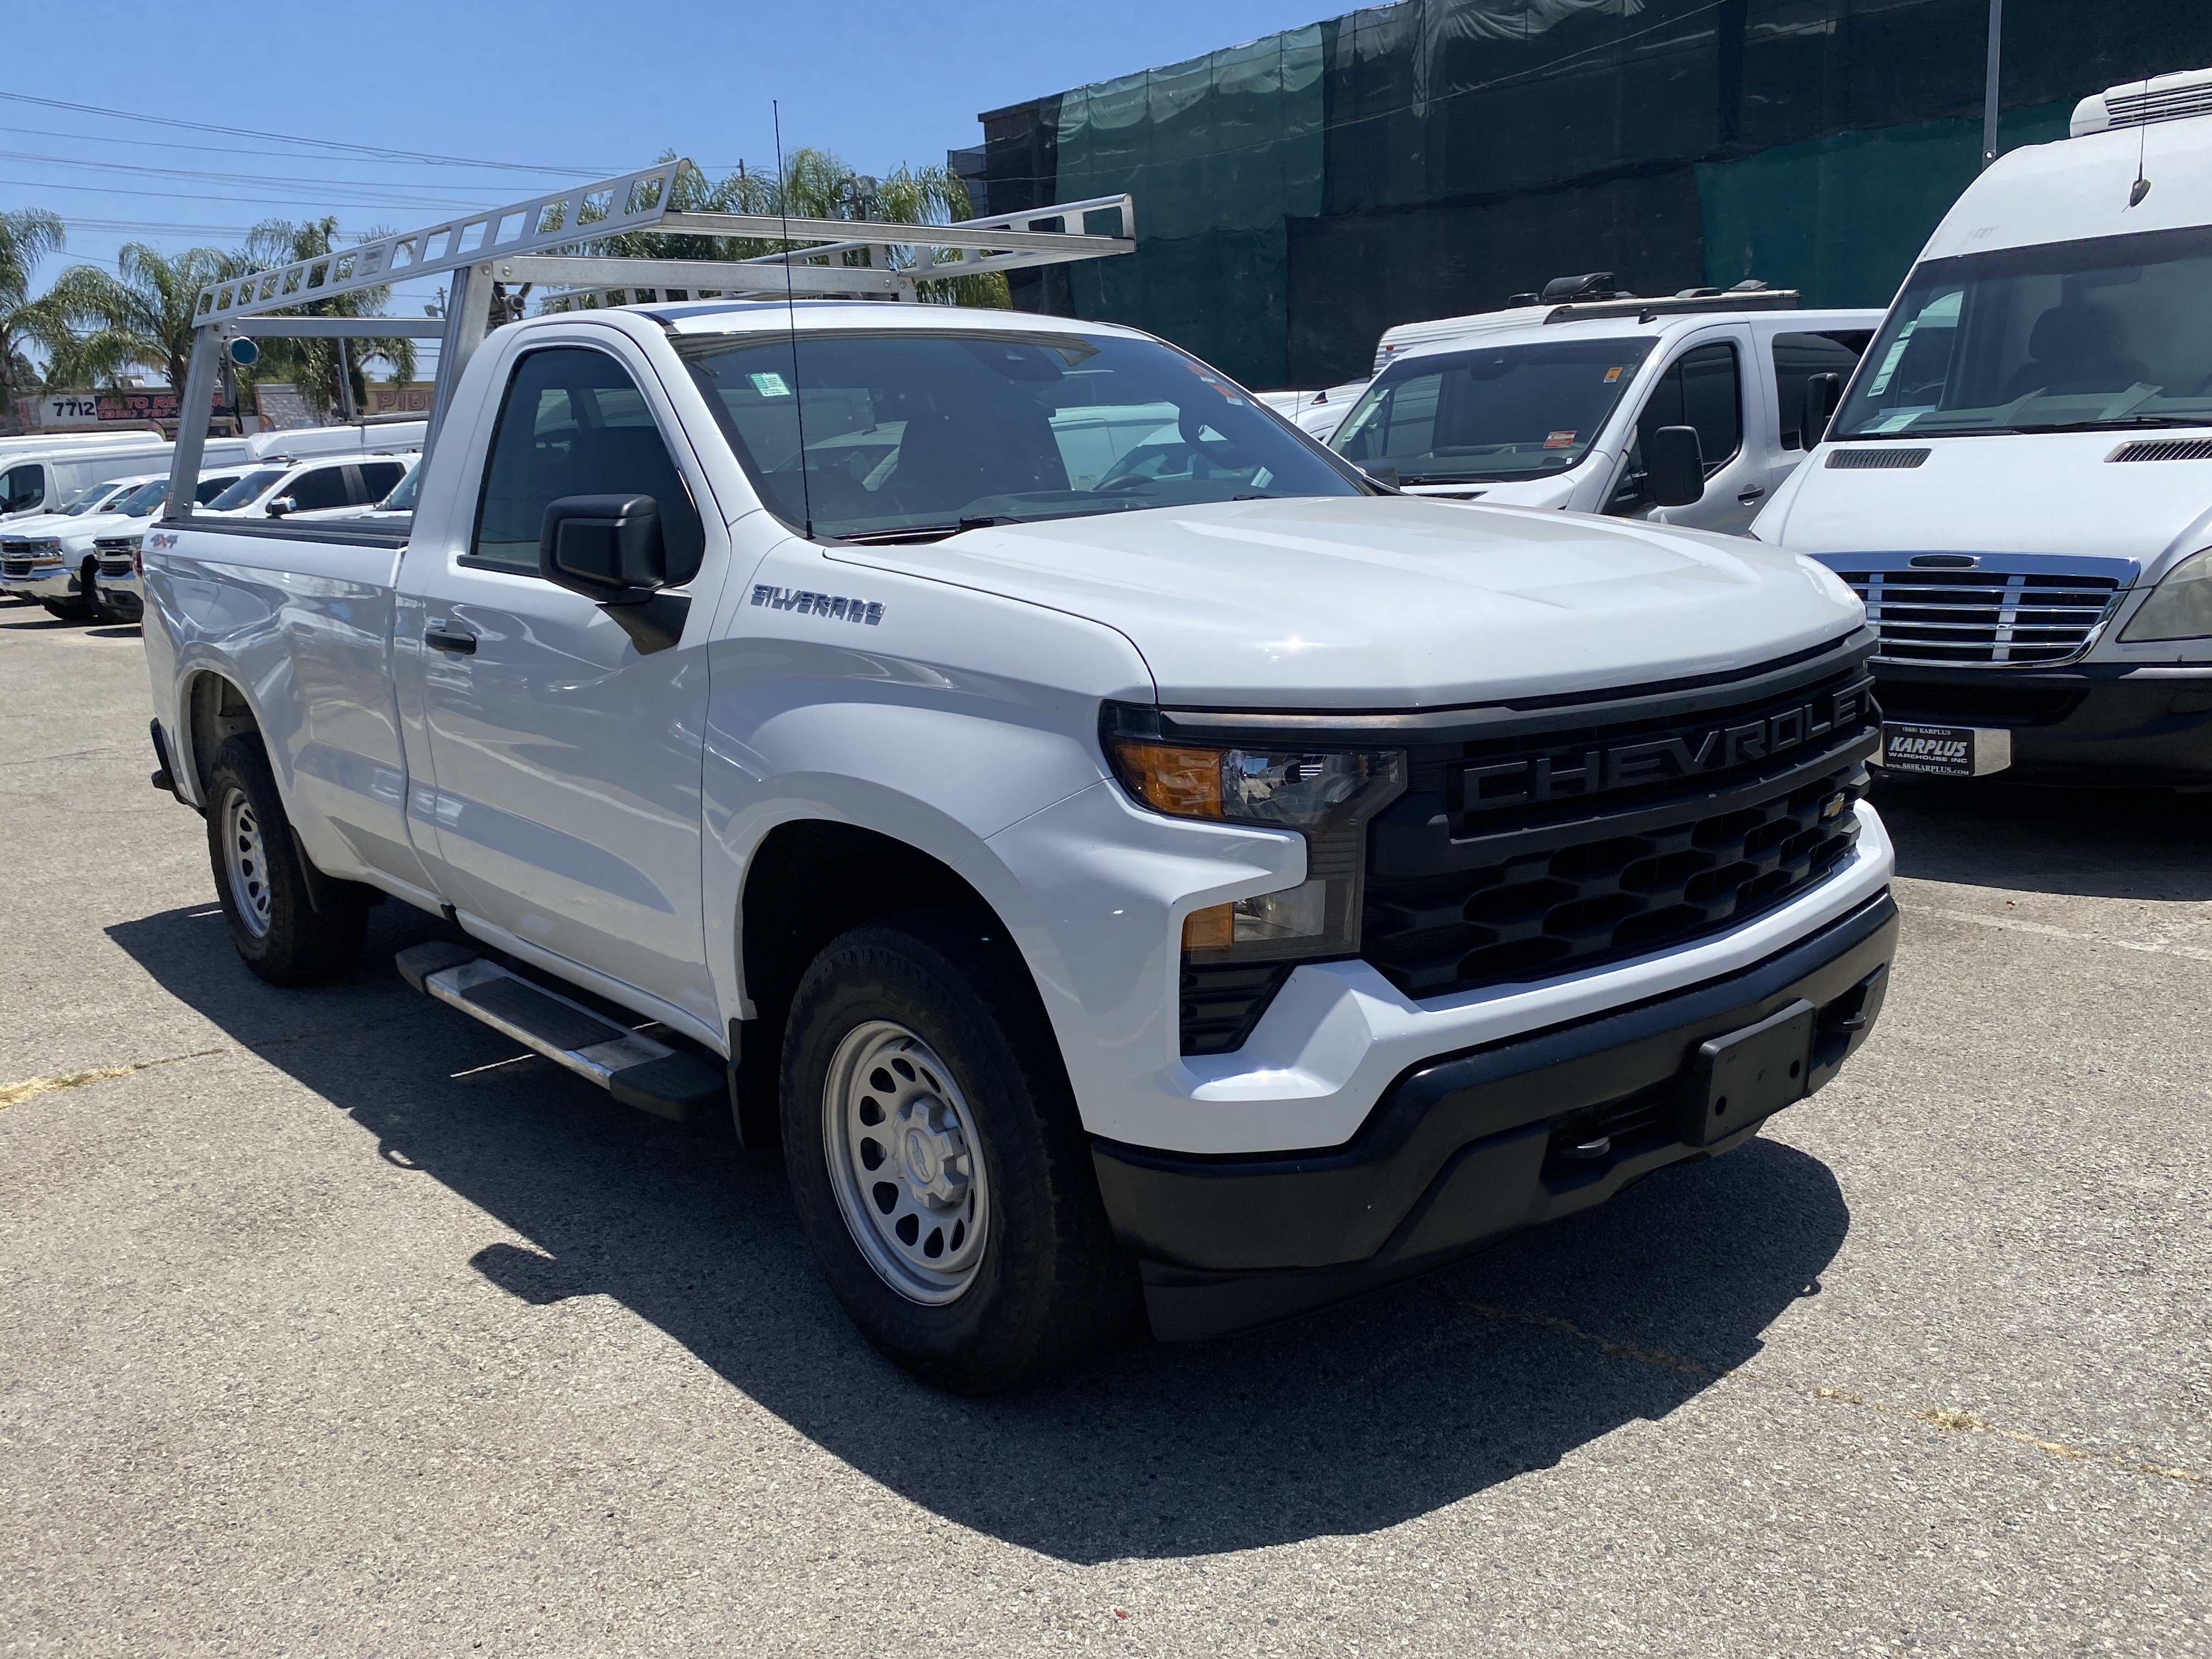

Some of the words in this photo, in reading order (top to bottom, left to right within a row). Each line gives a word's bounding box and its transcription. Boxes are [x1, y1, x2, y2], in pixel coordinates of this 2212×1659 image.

[53, 402, 95, 416] 7712
[97, 397, 148, 409] AUTO
[377, 392, 433, 411] PIB
[752, 584, 887, 621] SILVERADO
[1919, 727, 1951, 736] KARPLUS
[1464, 675, 1876, 811] CHEVROLET
[1889, 736, 1967, 757] KARPLUS
[1888, 752, 1948, 761] WAREHOUSE
